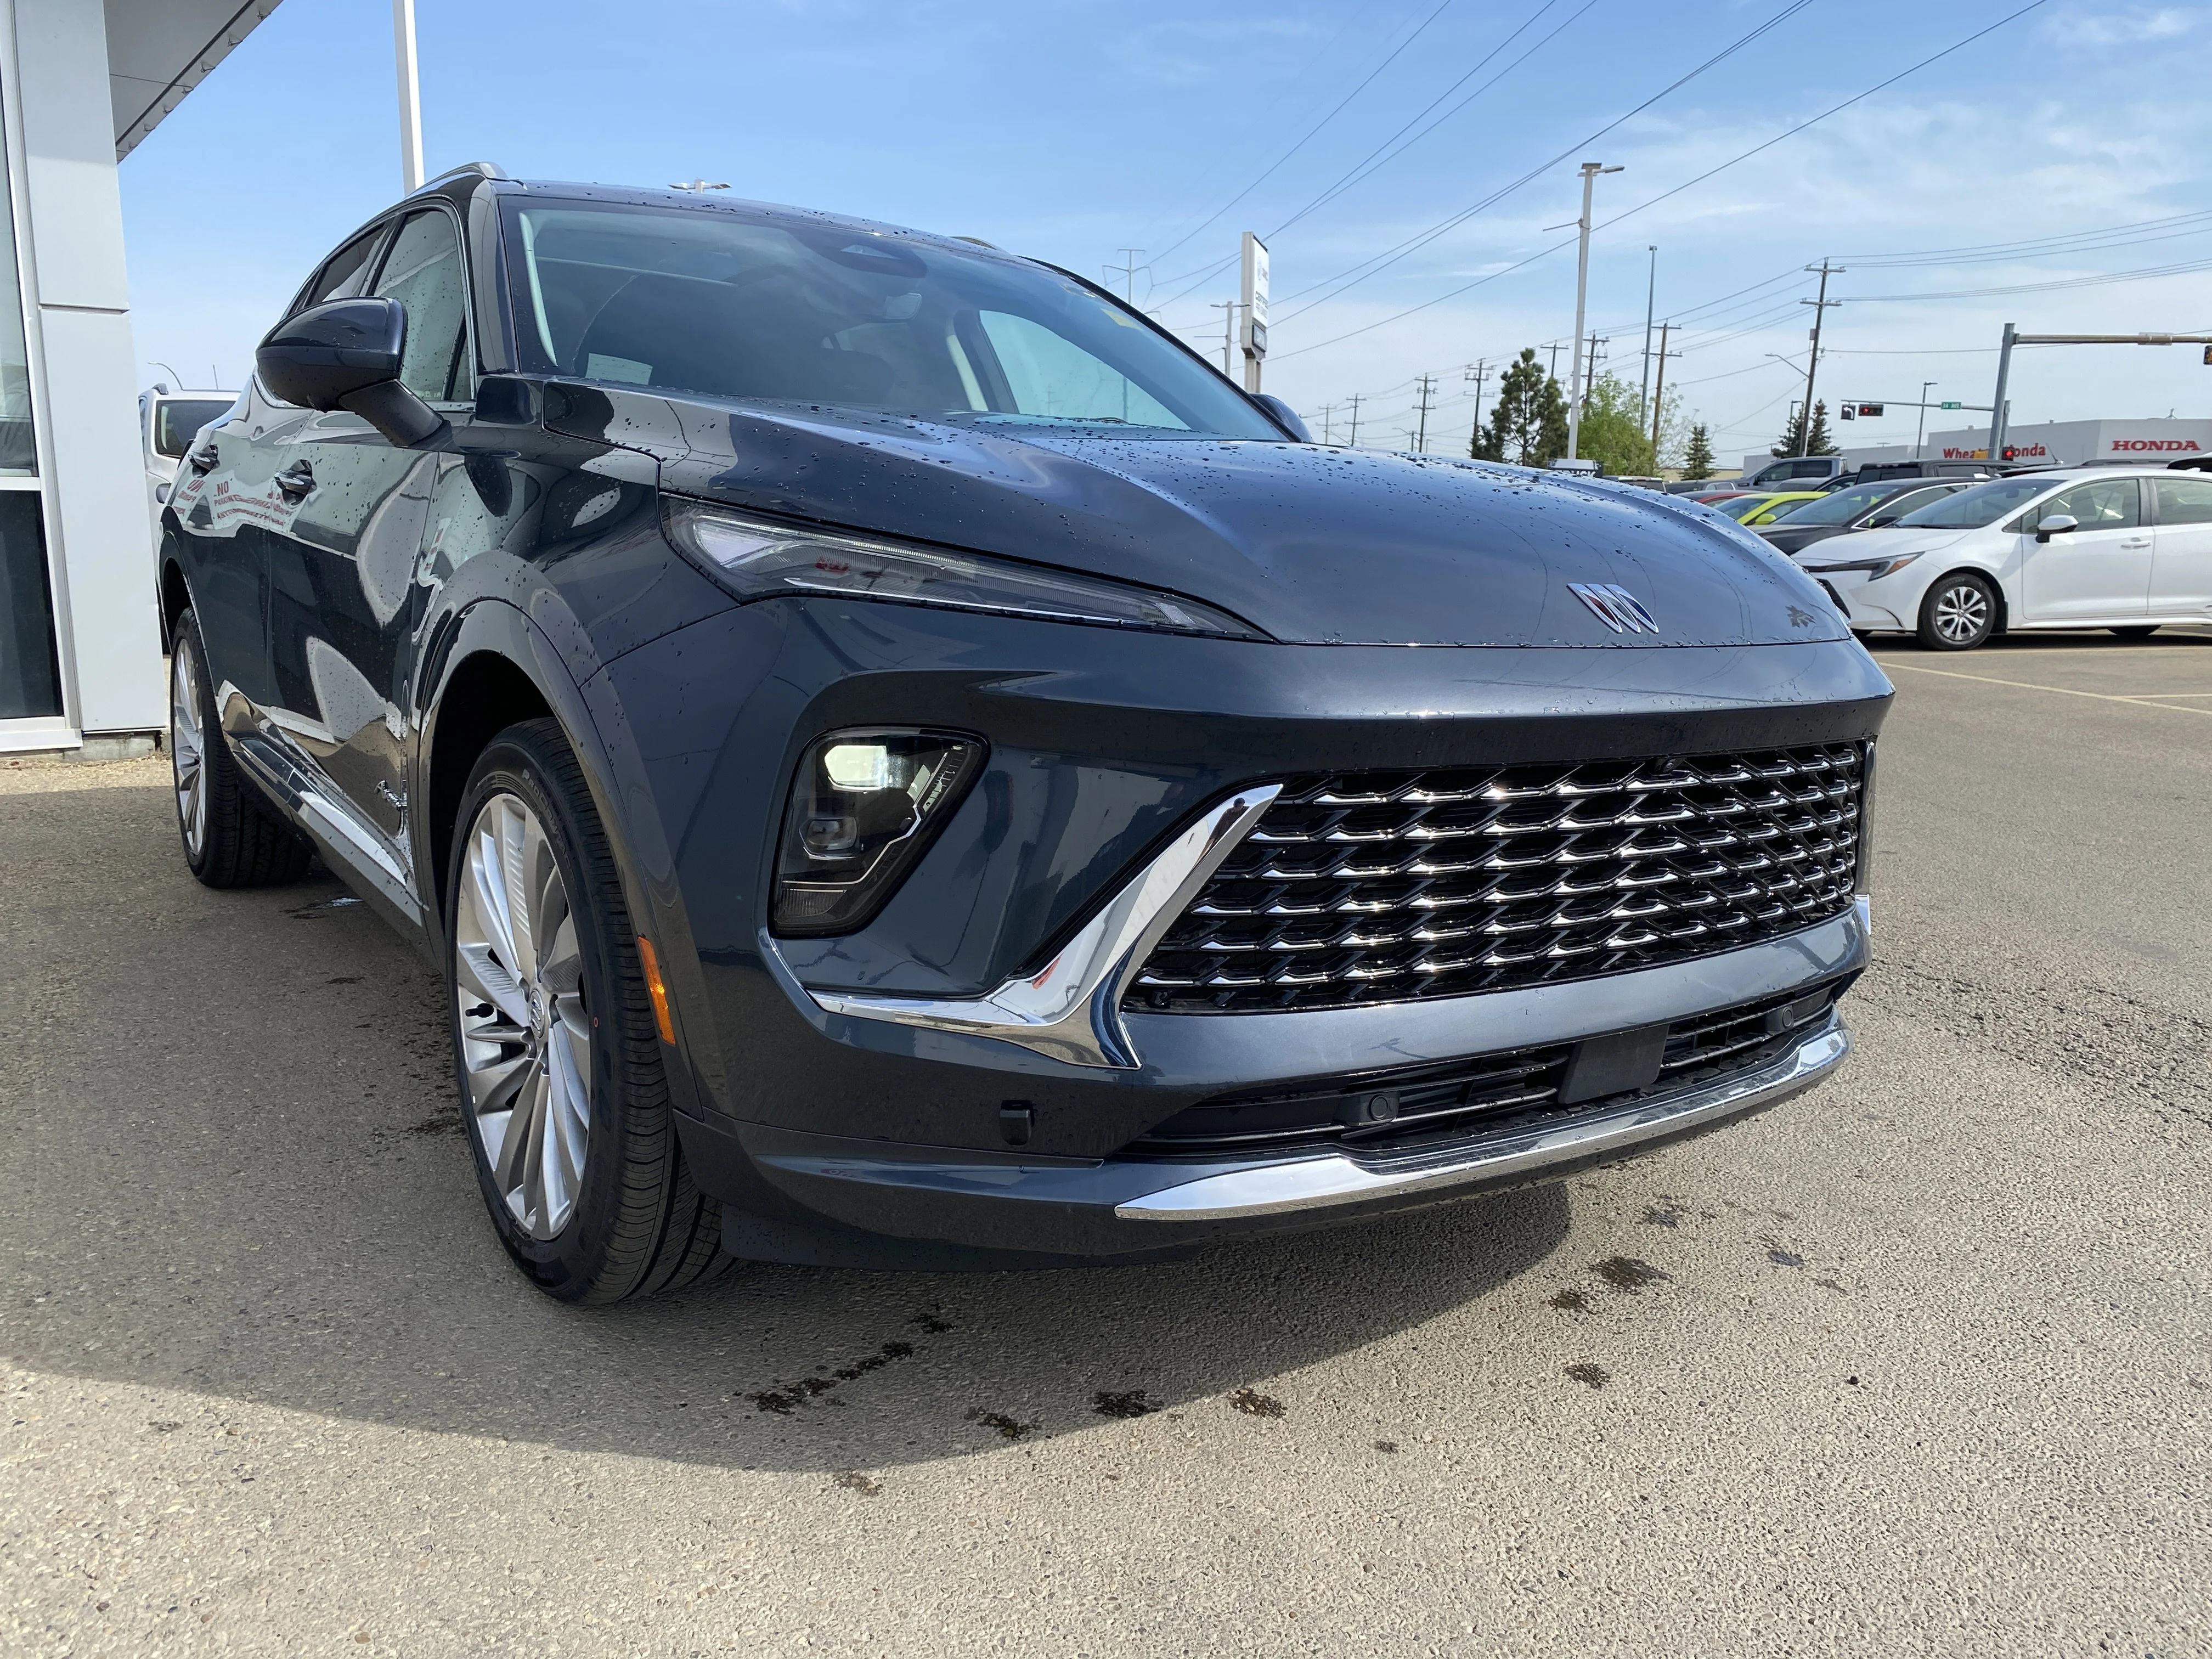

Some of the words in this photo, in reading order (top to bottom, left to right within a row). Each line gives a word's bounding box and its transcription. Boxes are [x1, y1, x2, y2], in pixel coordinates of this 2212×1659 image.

[1943, 447, 1976, 459] Whea
[2012, 443, 2046, 458] onda
[2112, 441, 2202, 451] HONDA
[217, 481, 229, 496] NO
